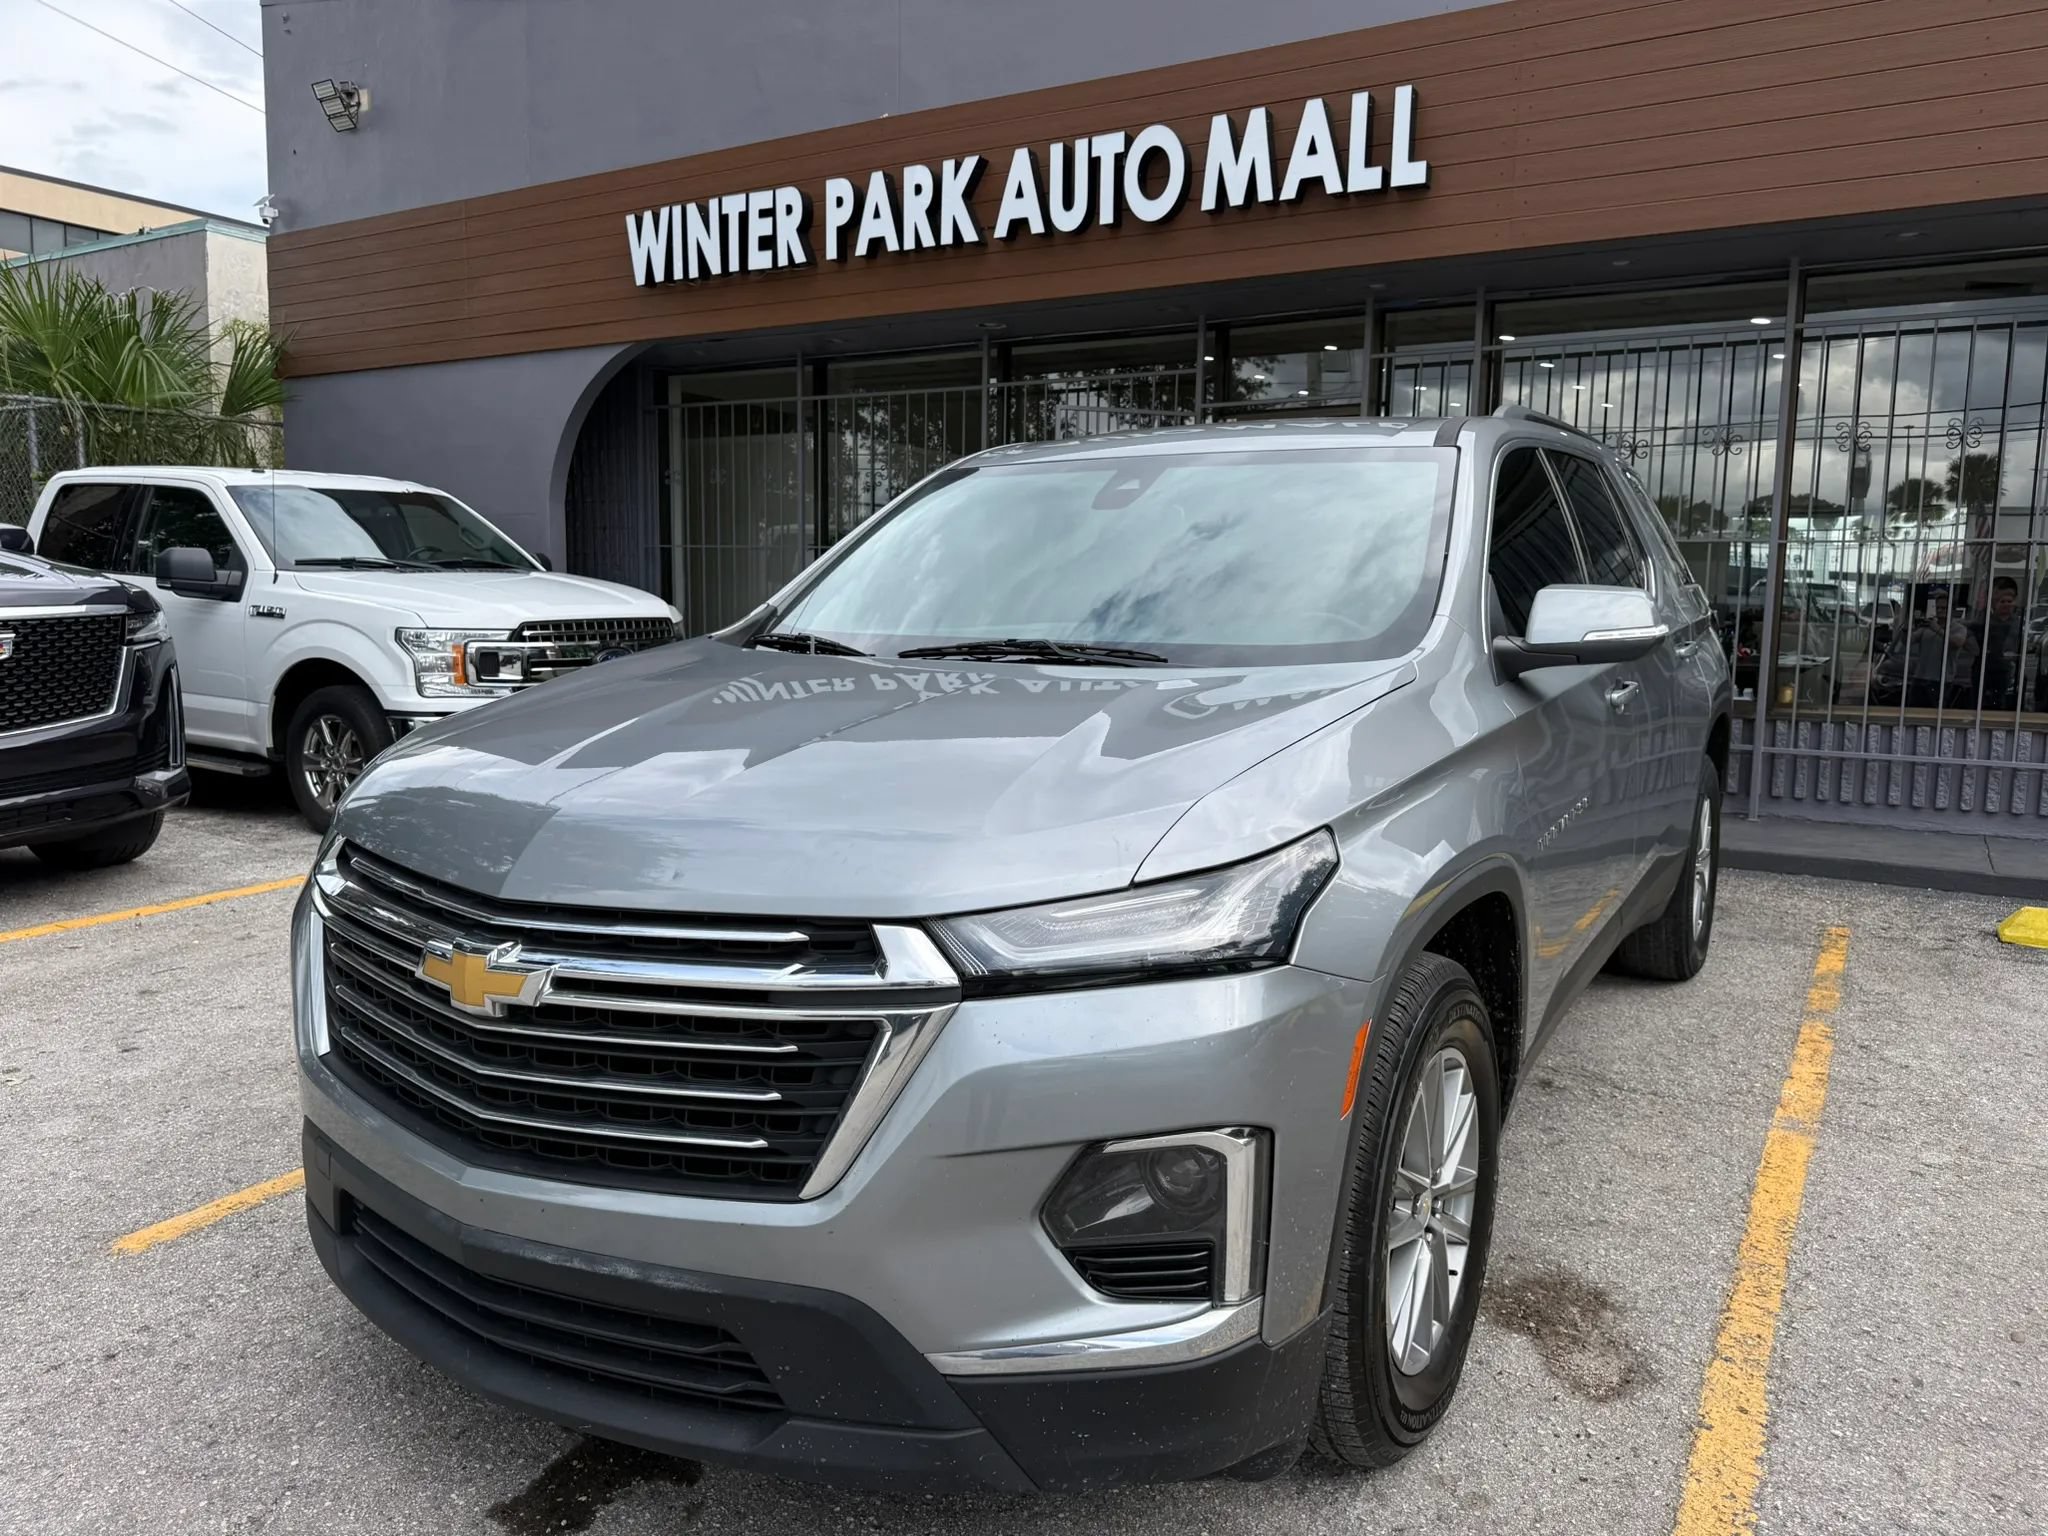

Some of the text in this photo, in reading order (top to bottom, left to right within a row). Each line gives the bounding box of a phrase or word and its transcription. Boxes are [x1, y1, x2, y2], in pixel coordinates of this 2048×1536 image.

[625, 84, 1428, 286] WINTER PARK AUTO MALL
